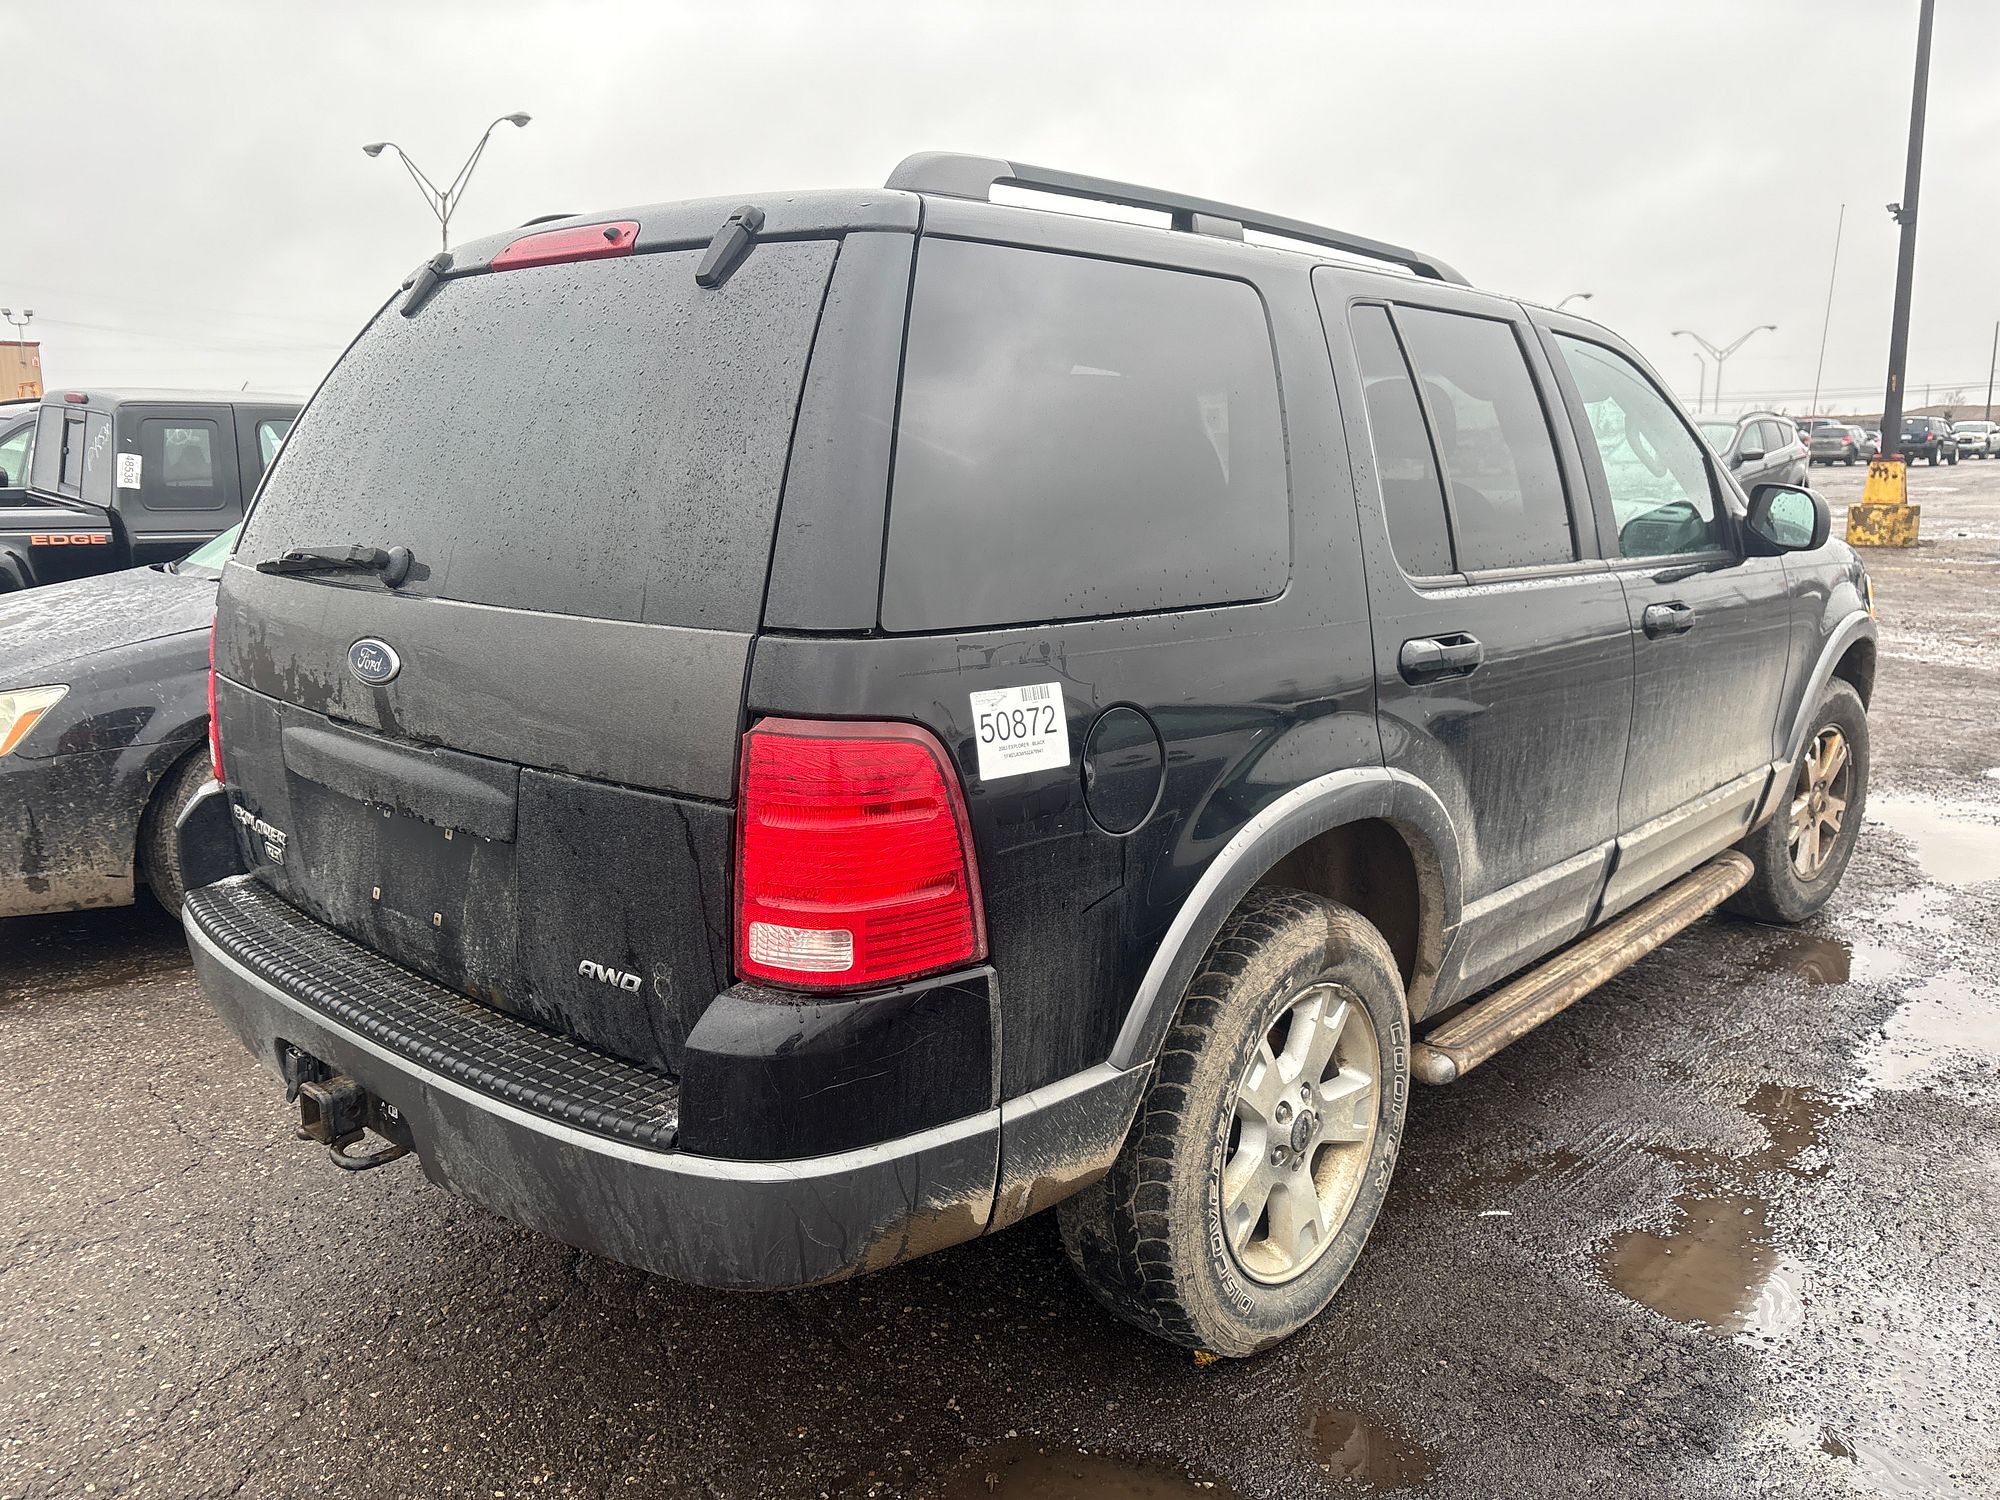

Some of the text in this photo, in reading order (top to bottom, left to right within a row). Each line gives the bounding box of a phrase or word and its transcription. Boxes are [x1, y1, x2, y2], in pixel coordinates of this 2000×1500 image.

[30, 534, 107, 546] EDGE
[357, 647, 383, 673] Ford
[980, 705, 1058, 743] 50872
[578, 959, 642, 993] AWD
[1374, 1021, 1405, 1193] COOPER
[1208, 1080, 1255, 1315] DISCOVERER
